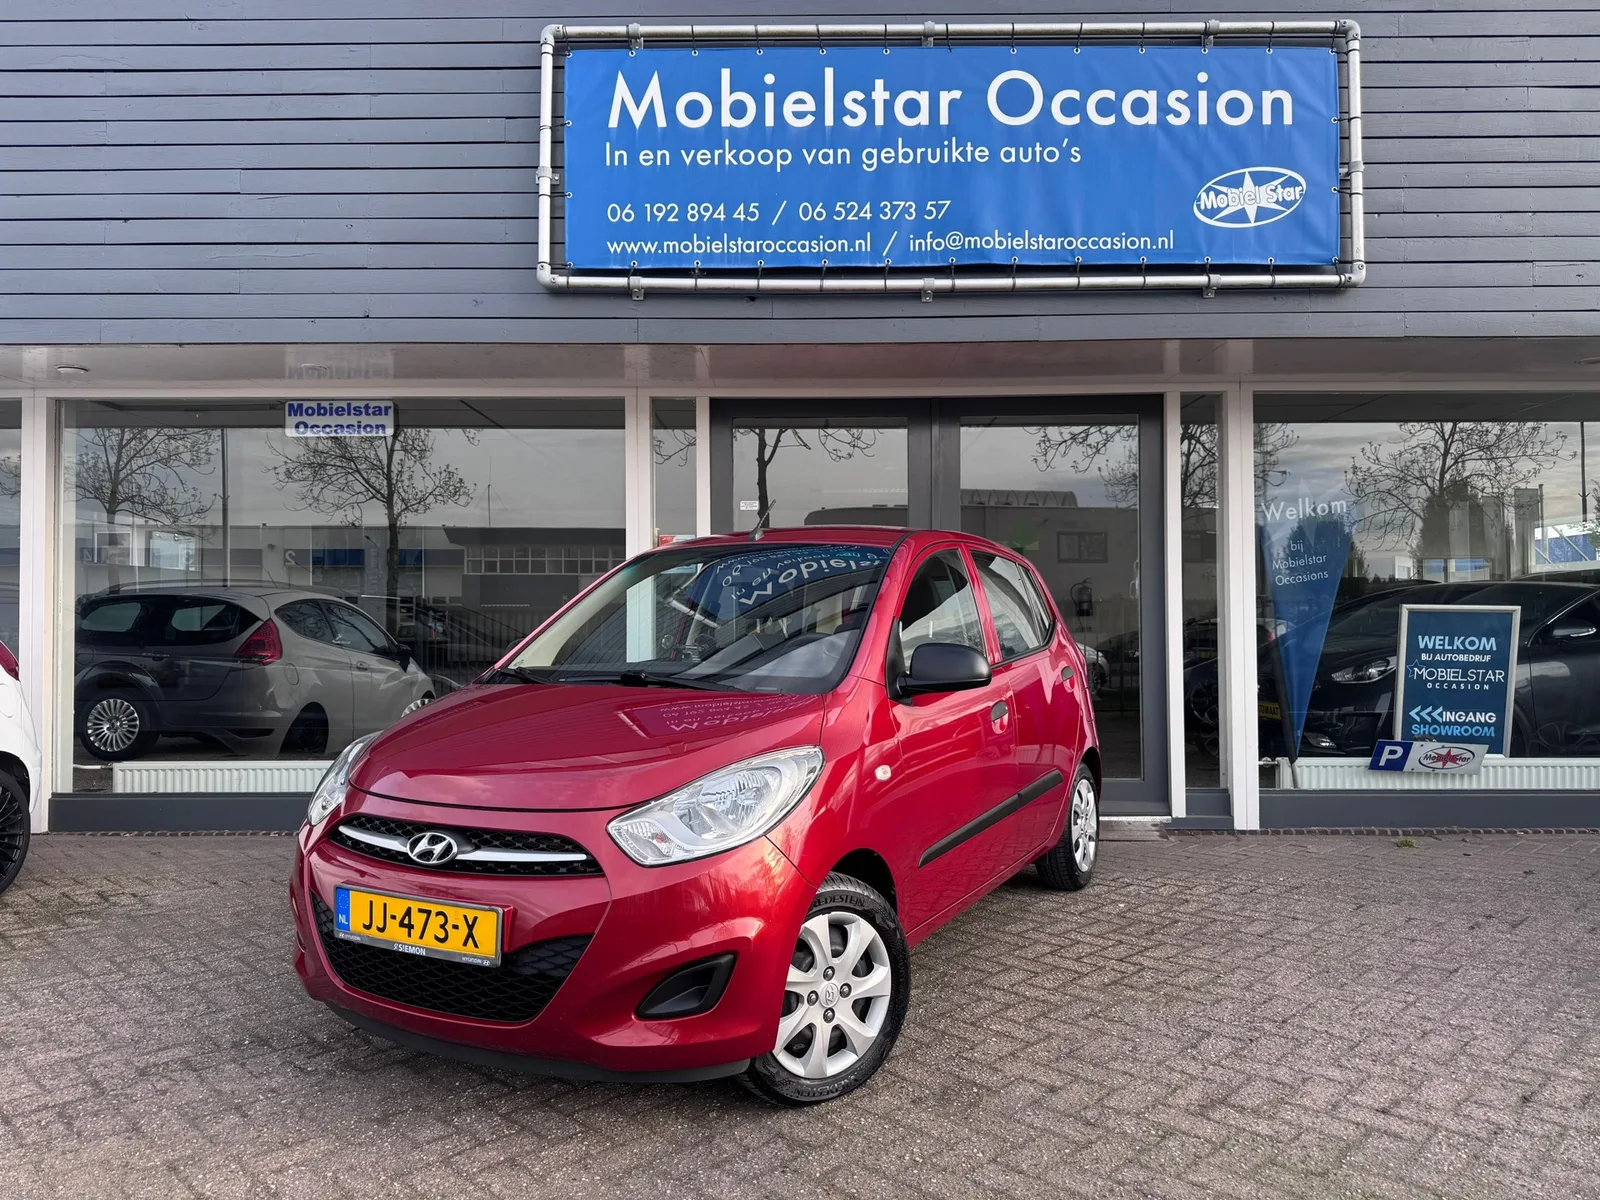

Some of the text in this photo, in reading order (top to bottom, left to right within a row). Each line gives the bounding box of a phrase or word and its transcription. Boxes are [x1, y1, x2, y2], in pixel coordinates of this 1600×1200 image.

[608, 67, 1293, 129] Mobielstar Occasion
[606, 137, 1082, 172] In en verkoop van gebruikte auto's
[1200, 184, 1303, 210] Mobiel Star
[607, 200, 951, 226] 06 192 894 45 / 06 524 373 57
[607, 230, 1174, 257] www.mobielstaroccasion.nl / info@mobielstaroccasion.nl
[287, 403, 392, 417] Mobielstar
[294, 421, 387, 435] Occasion
[1261, 497, 1347, 522] Welkom
[1290, 540, 1304, 553] bij
[1272, 554, 1327, 570] Mobielstar
[1275, 570, 1329, 586] Occasions
[1418, 635, 1497, 651] WELKOM
[1421, 653, 1492, 663] BIJ AUTOBEDRIJF
[1413, 667, 1505, 683] MOBIELSTAR
[1426, 682, 1490, 690] OCCASION
[1443, 711, 1496, 723] INGANG
[1411, 724, 1495, 737] SHOWROOM
[1379, 745, 1404, 767] P
[1455, 753, 1471, 763] Star
[339, 914, 348, 925] NL
[362, 900, 480, 949] JJ-473-X
